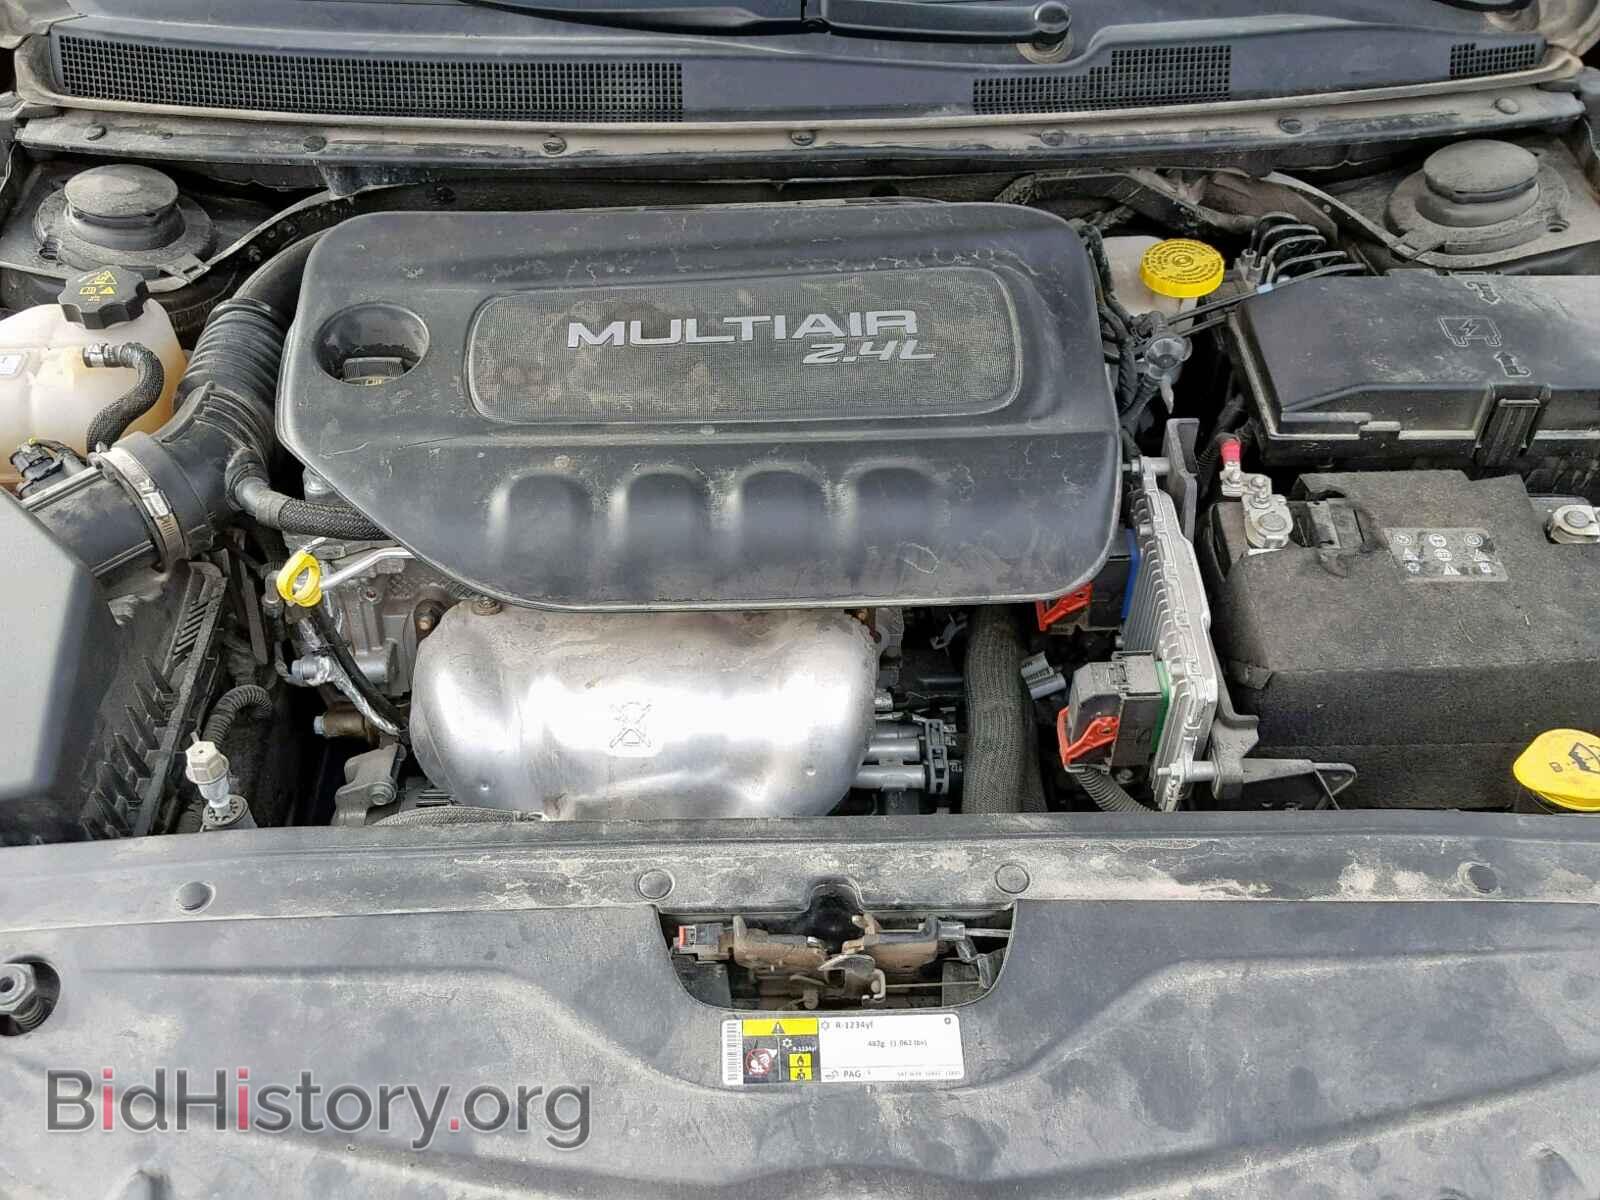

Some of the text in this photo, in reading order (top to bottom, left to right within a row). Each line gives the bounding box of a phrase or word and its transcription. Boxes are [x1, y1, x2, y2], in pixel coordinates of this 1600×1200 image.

[567, 310, 919, 348] MULTIAIR
[802, 340, 937, 365] 2.4L
[843, 1070, 862, 1079] PAG
